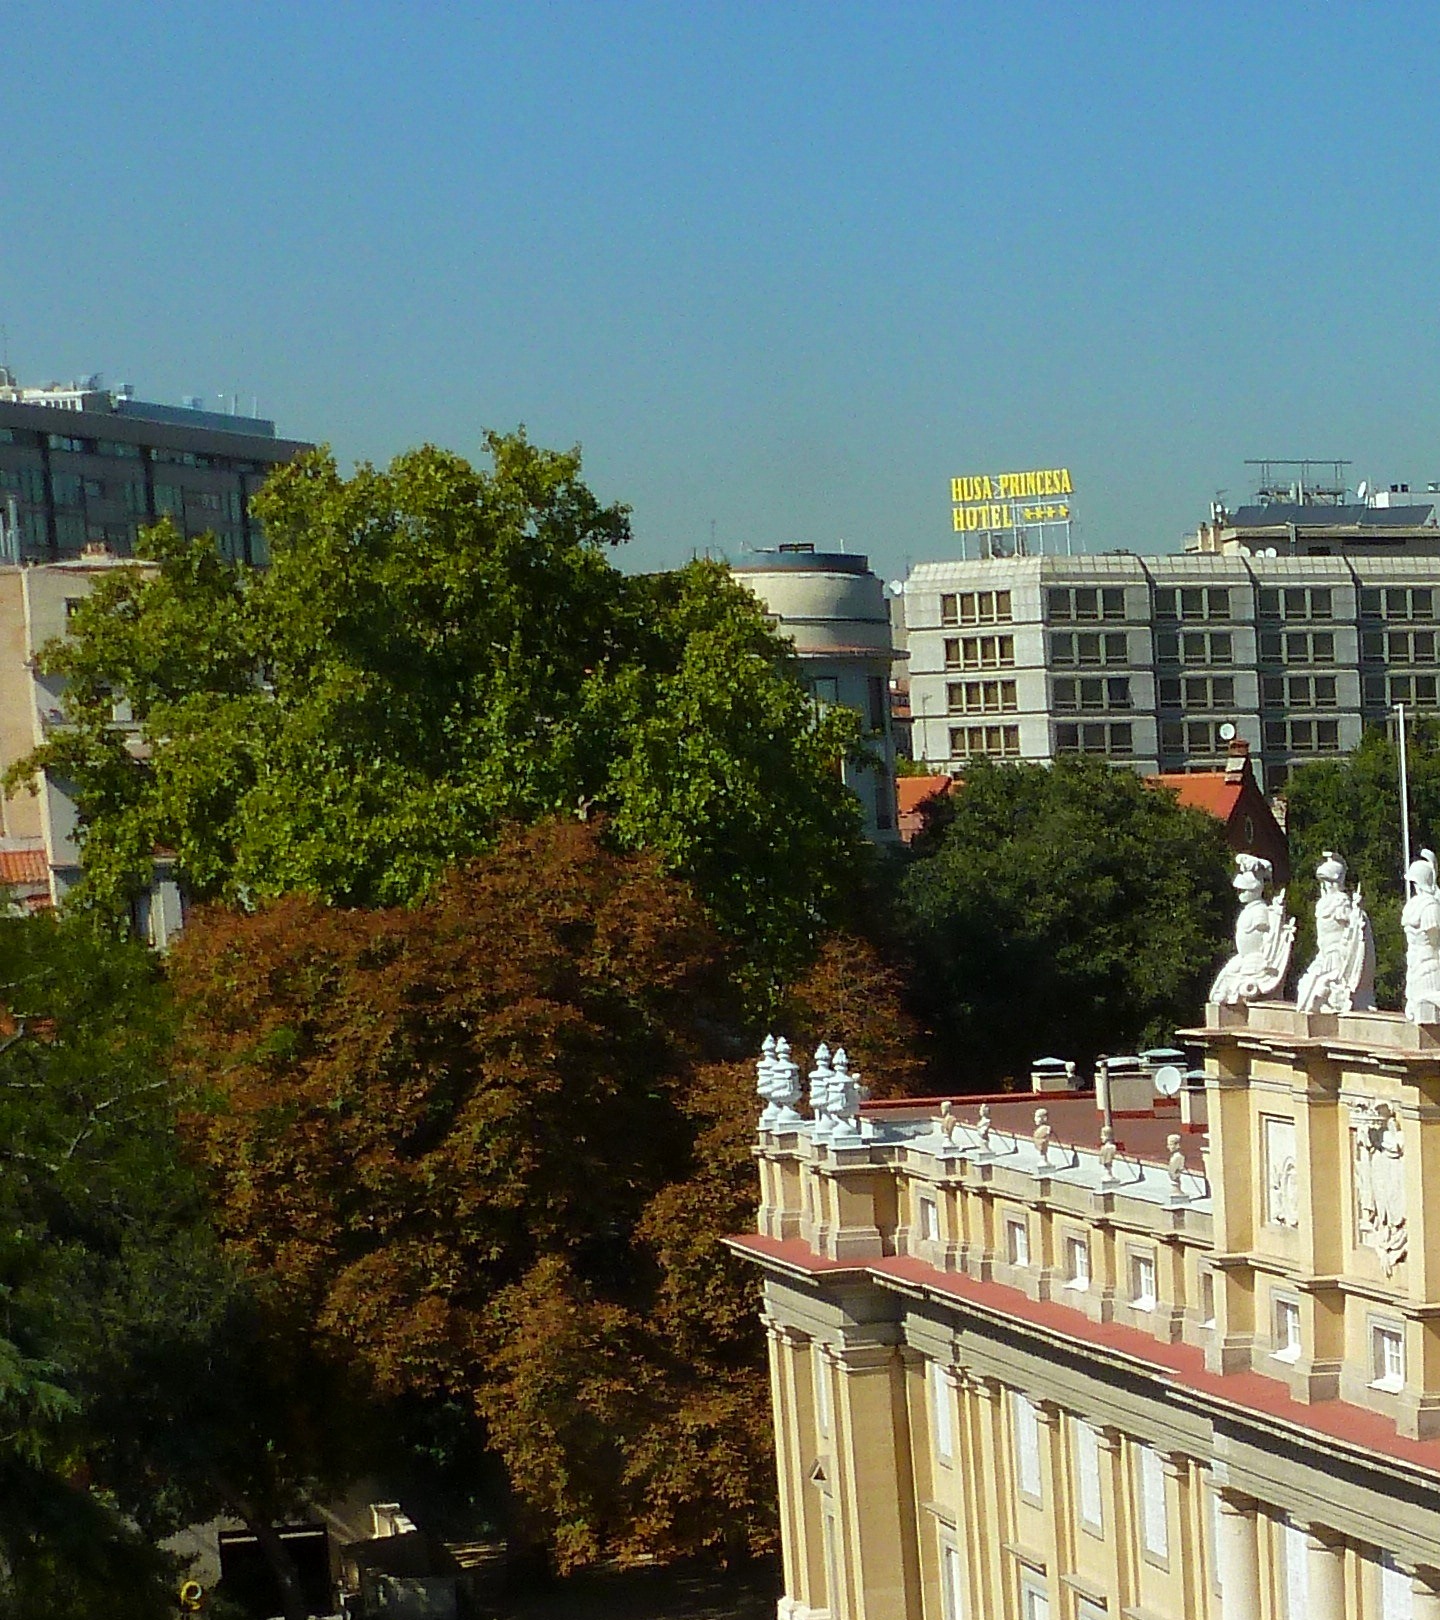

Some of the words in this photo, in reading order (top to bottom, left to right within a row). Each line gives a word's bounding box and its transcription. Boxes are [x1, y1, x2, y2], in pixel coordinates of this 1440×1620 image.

[951, 475, 992, 502] HUSA
[999, 468, 1072, 498] PRINCESA
[953, 504, 1012, 532] HOTEL
